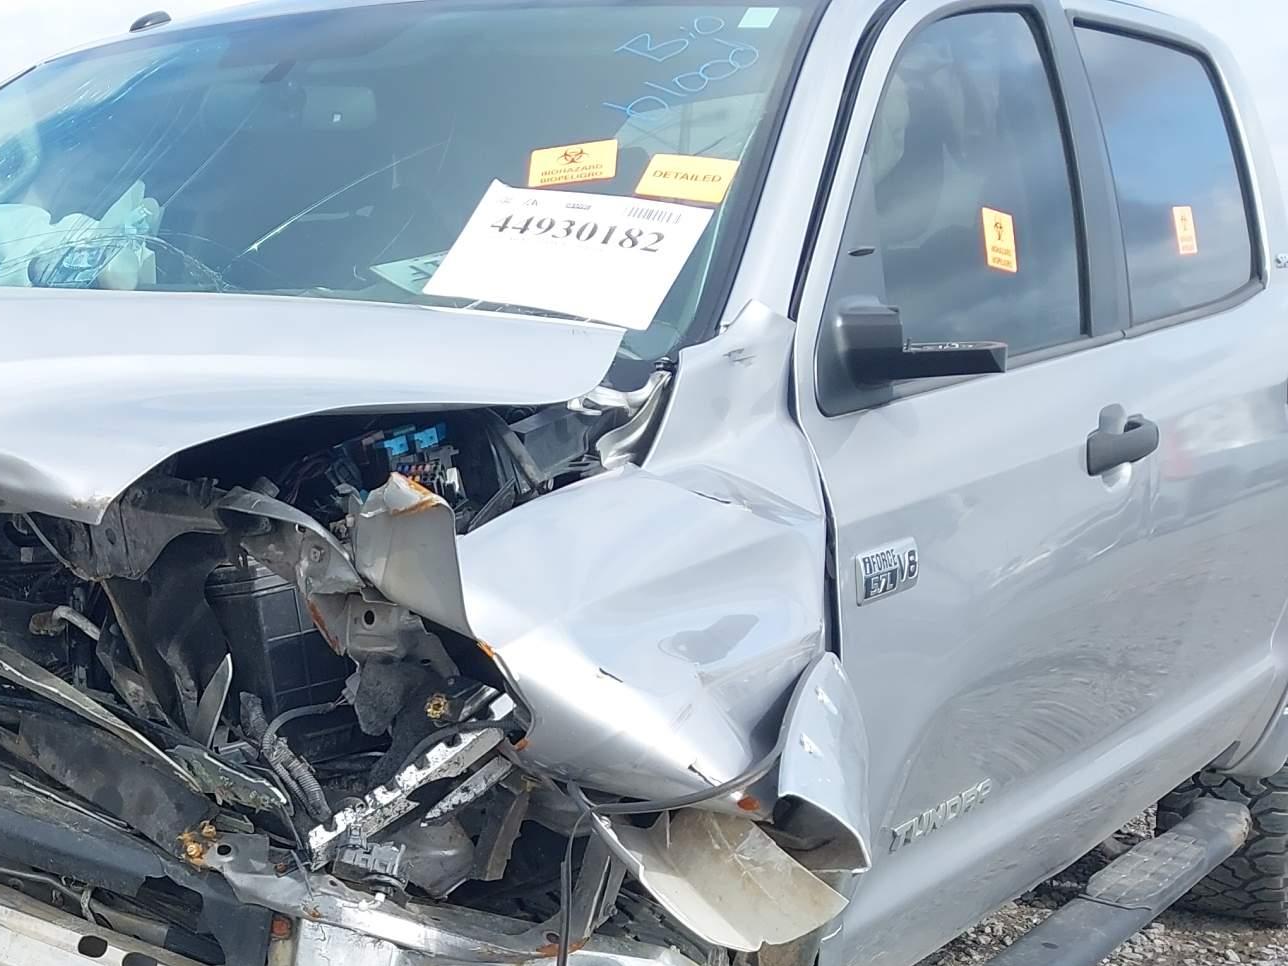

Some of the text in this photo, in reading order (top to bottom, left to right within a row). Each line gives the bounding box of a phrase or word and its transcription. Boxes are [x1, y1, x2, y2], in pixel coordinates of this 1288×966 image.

[541, 163, 604, 177] BIOHAZARD
[652, 169, 723, 184] DETAILED
[490, 214, 665, 253] 44930182
[897, 549, 918, 583] V8
